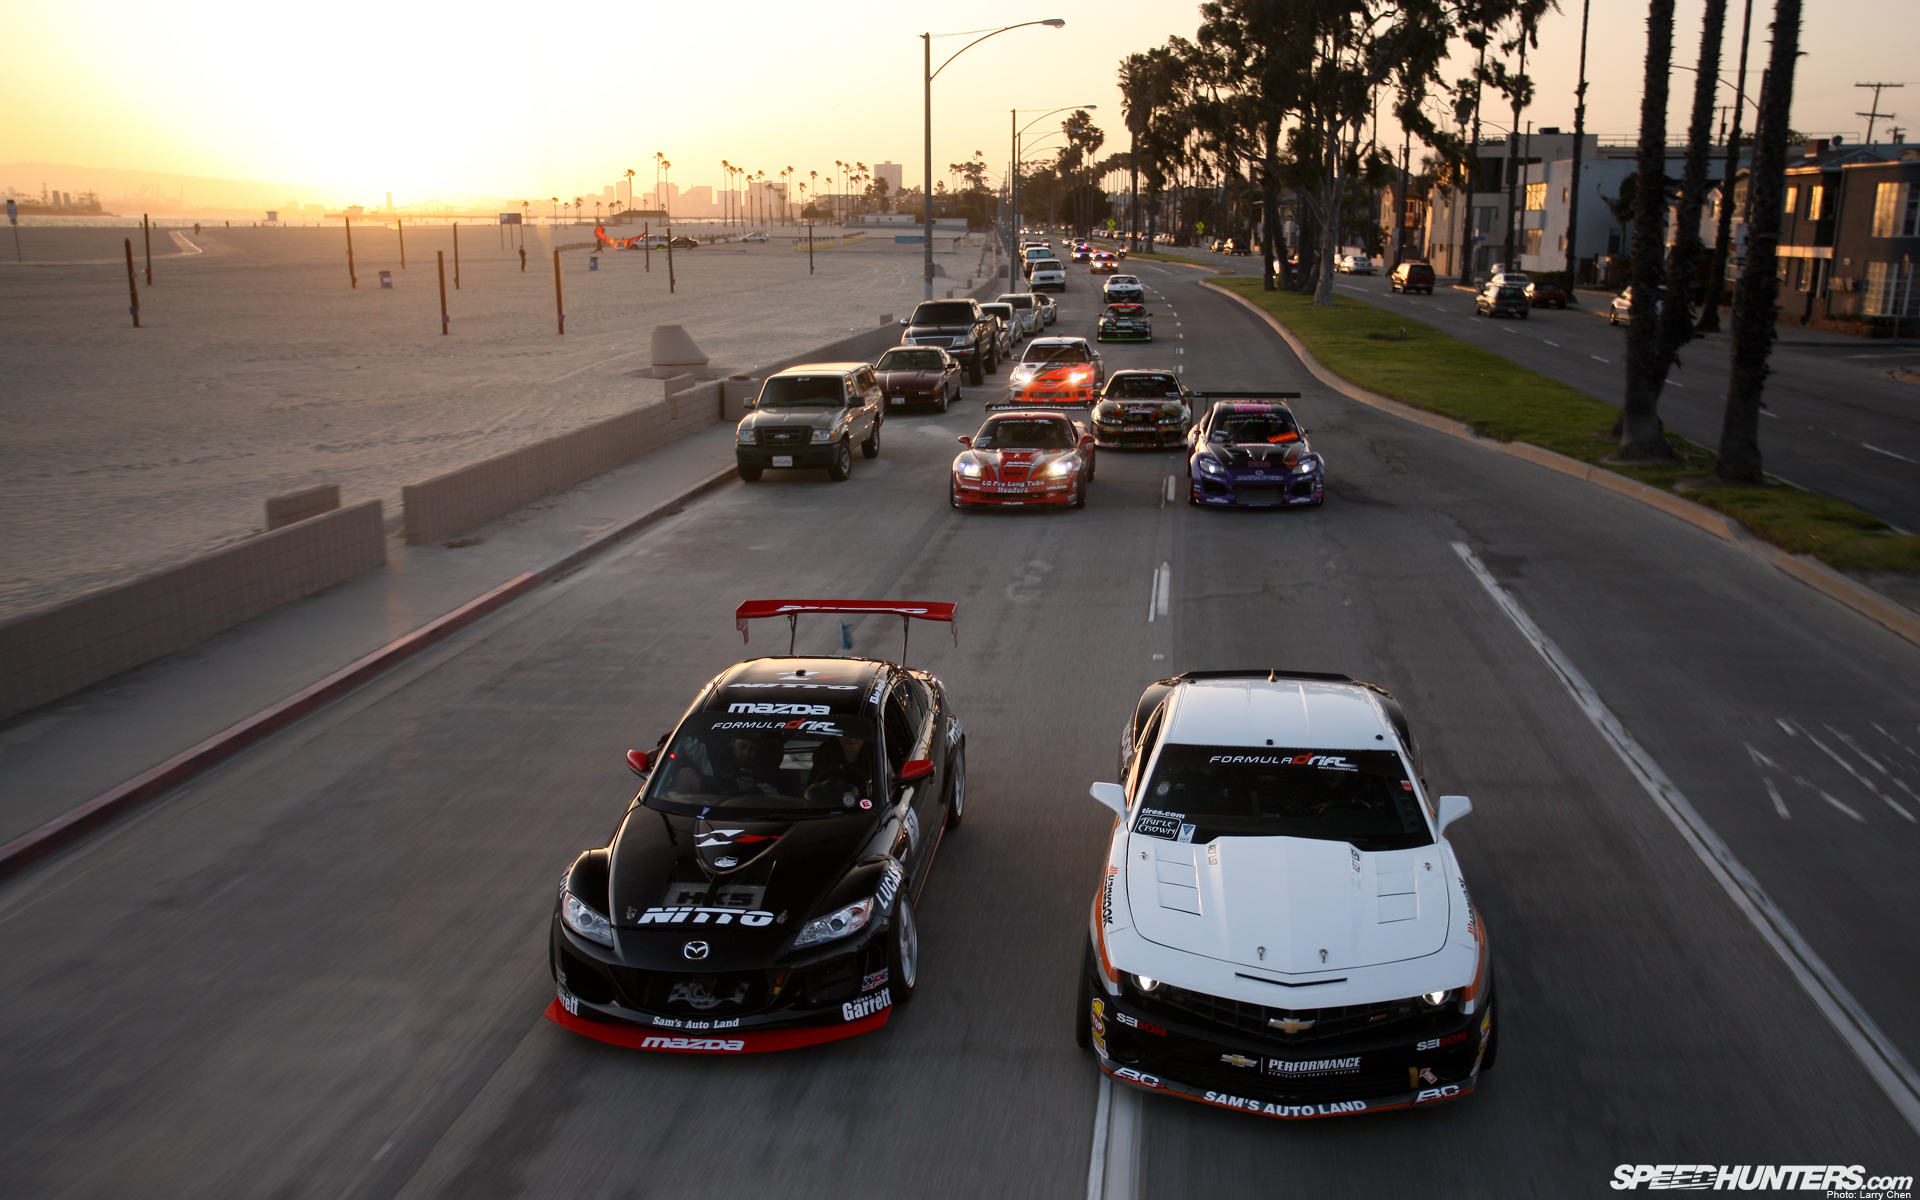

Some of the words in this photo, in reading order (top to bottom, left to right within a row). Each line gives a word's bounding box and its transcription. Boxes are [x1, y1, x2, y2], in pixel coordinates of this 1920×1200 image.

[728, 683, 859, 691] NITTO
[1141, 808, 1186, 819] tires.com
[1138, 825, 1176, 835] CROWN
[1140, 817, 1176, 828] TRIPLE
[676, 891, 754, 906] HKS
[637, 907, 774, 927] NITTO
[842, 987, 893, 1022] Garrett
[652, 1016, 682, 1028] Sam's
[685, 1020, 709, 1029] Auto
[713, 1018, 739, 1029] Land
[1116, 1012, 1167, 1037] SEIBON
[1416, 1031, 1467, 1051] SEIBON
[1268, 1057, 1361, 1072] PERFORMANCE
[1203, 1090, 1260, 1111] SAM'S
[1263, 1103, 1315, 1117] AUTO
[1318, 1100, 1367, 1115] LAND
